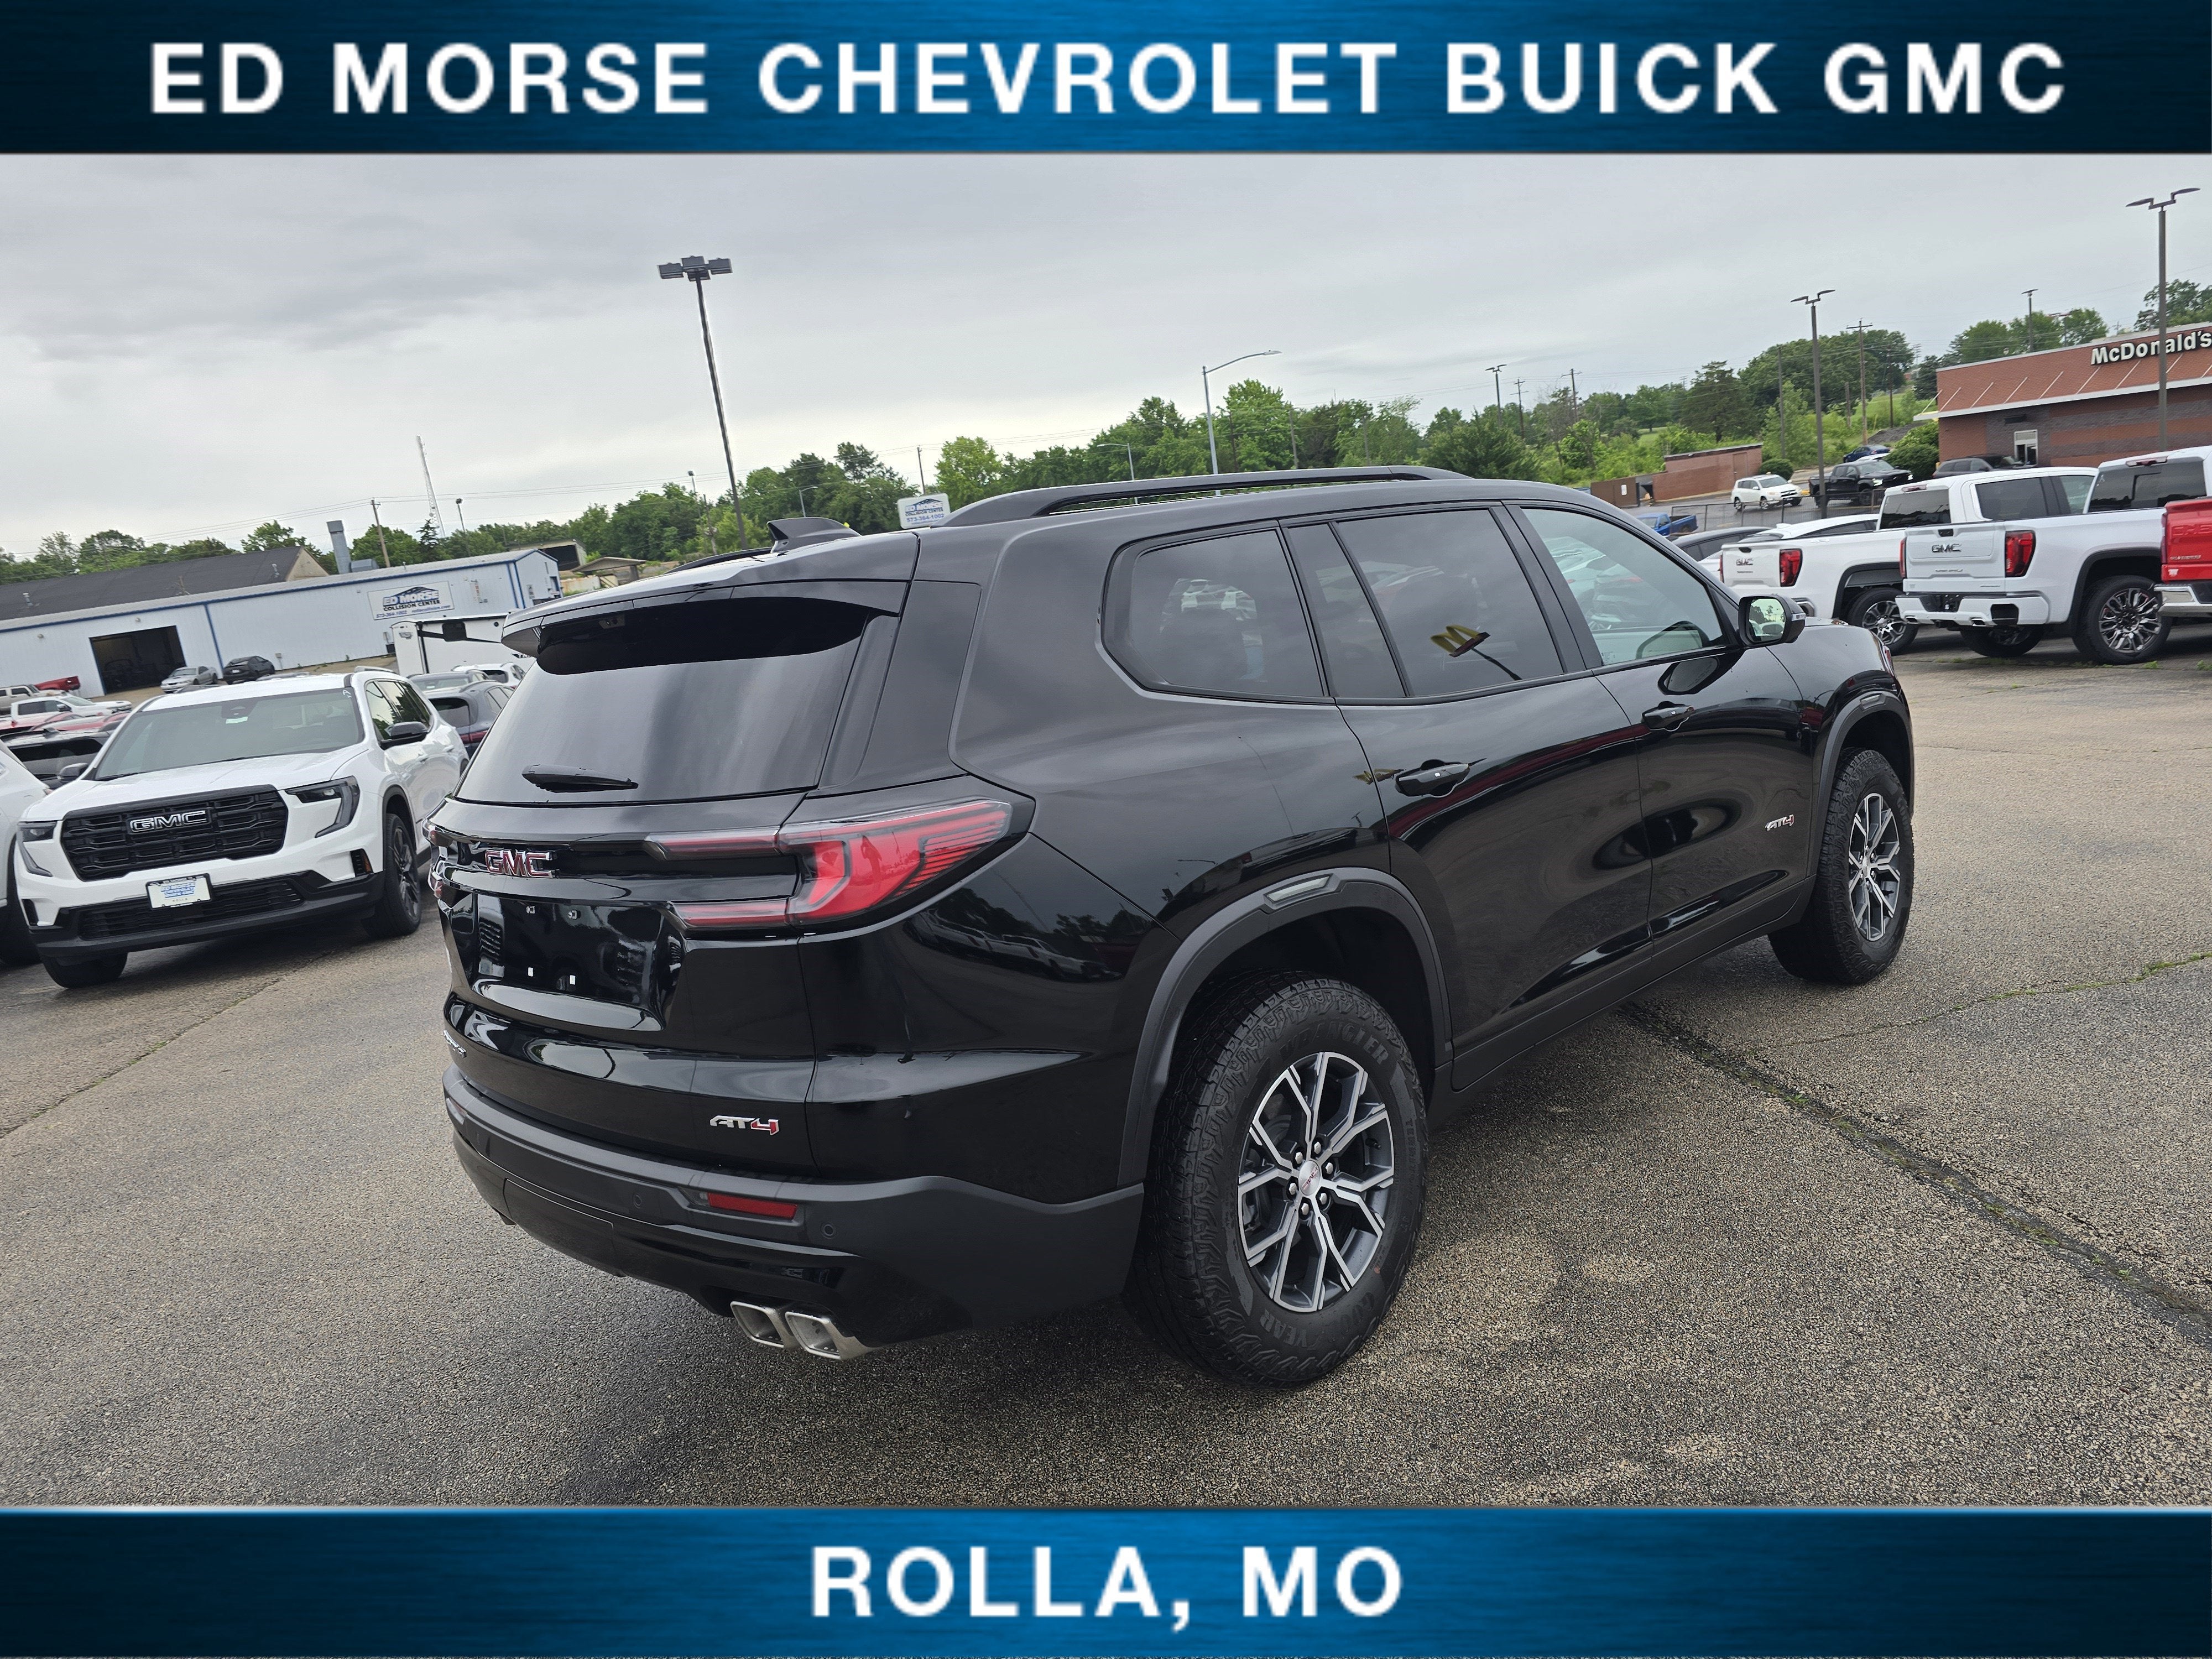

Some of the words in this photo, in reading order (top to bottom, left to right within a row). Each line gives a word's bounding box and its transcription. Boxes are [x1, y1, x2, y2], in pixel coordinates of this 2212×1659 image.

[2090, 330, 2212, 365] McDonald's
[1932, 544, 1962, 553] GMC
[383, 596, 398, 607] ED
[399, 590, 439, 604] MORSE
[383, 602, 416, 612] COLLISION
[129, 810, 207, 832] GMC
[1765, 814, 1794, 831] AT4
[485, 849, 553, 878] GMC
[709, 1115, 779, 1136] AT4
